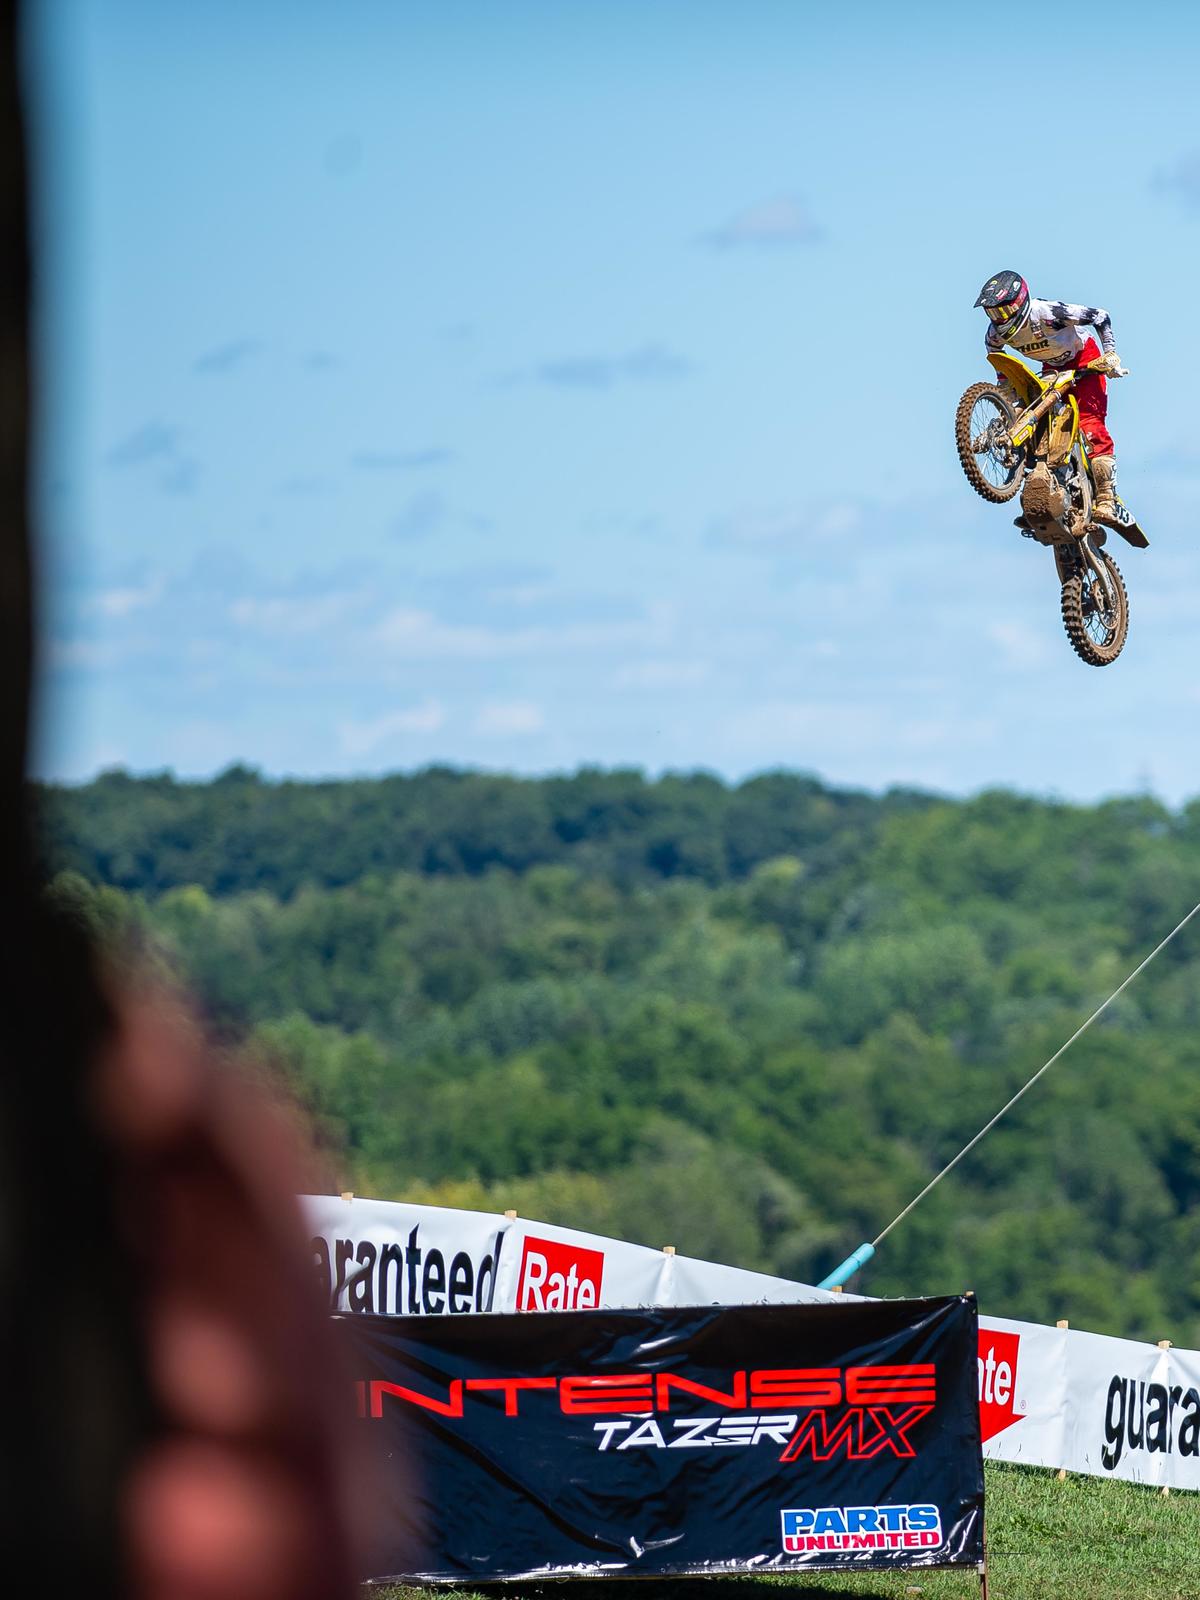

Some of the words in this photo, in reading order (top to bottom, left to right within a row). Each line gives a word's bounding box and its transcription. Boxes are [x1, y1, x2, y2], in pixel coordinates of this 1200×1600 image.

[525, 1251, 596, 1311] Rate
[355, 1363, 935, 1417] INTENSE
[594, 1415, 798, 1450] TAZER
[779, 1405, 935, 1462] MX
[783, 1505, 939, 1536] PARTS
[784, 1531, 940, 1551] UNLIMITED
